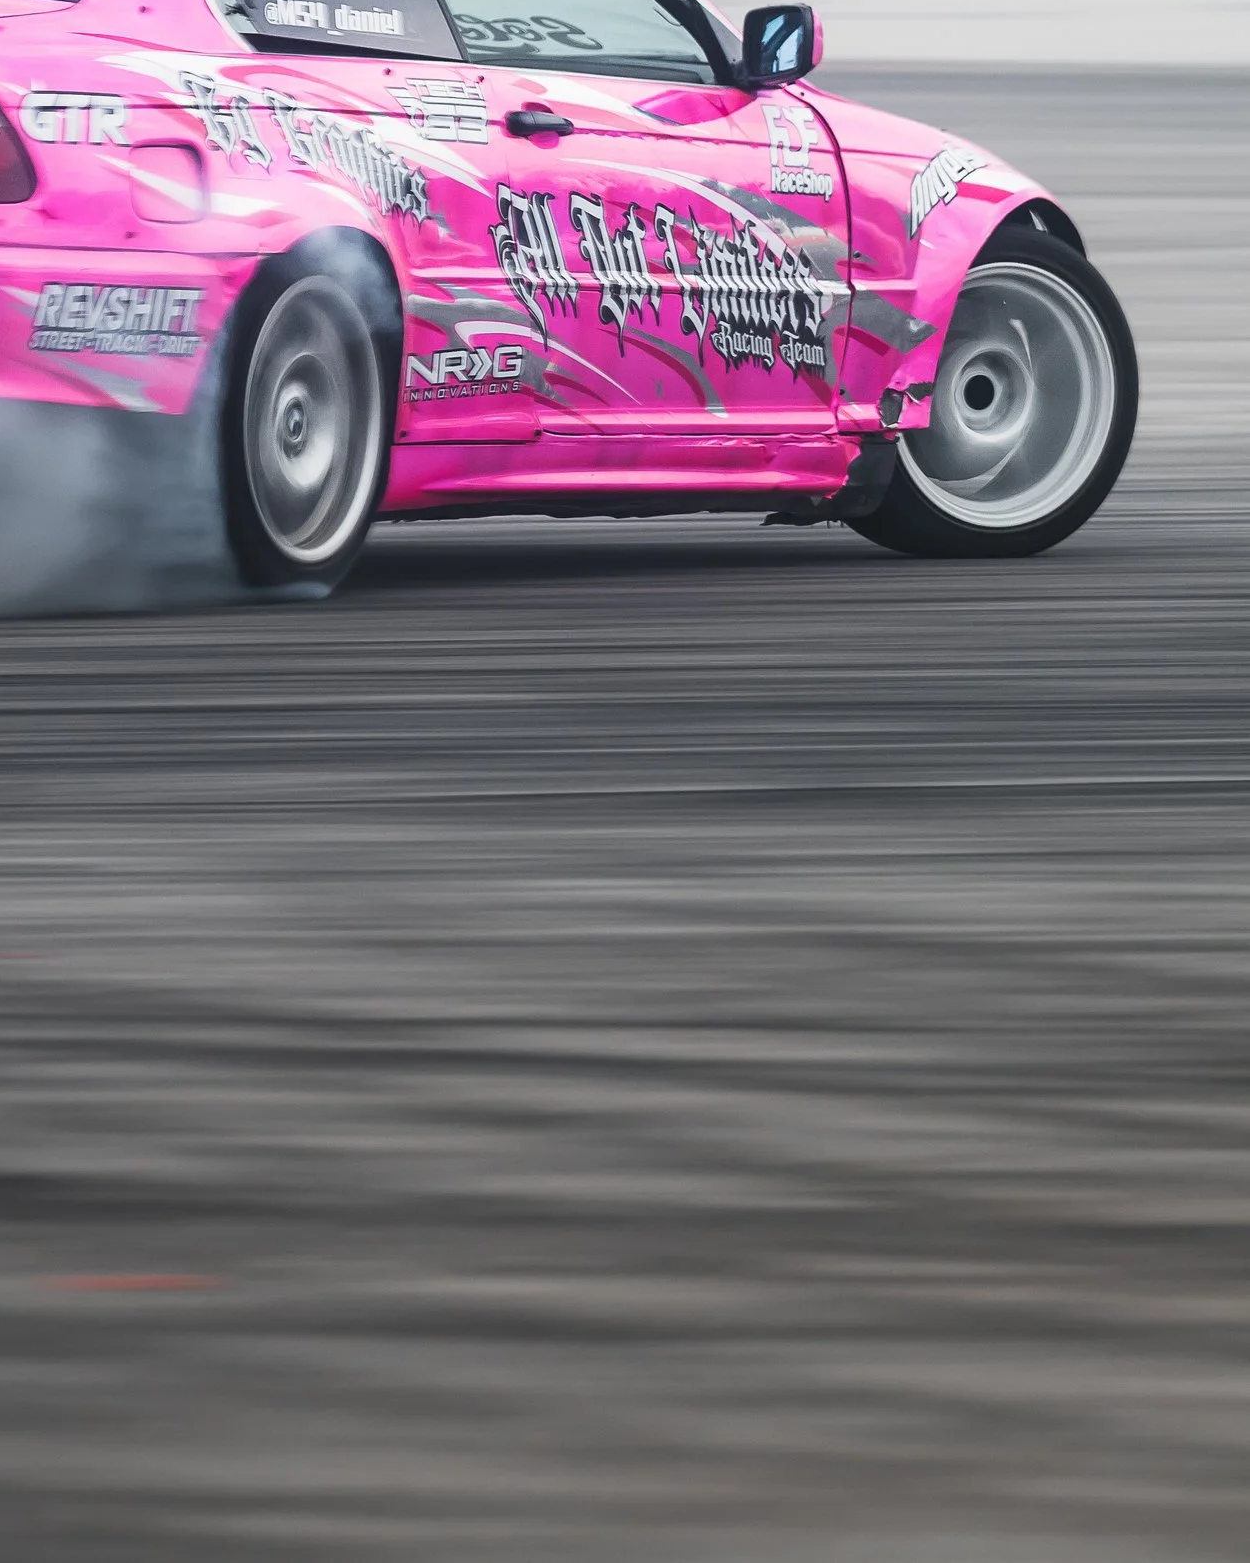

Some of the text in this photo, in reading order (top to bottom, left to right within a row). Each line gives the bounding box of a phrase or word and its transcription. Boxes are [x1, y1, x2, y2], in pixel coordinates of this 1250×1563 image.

[18, 91, 130, 147] GTR
[771, 167, 834, 203] RaceShop
[34, 282, 206, 333] REVSHIFT
[711, 321, 826, 372] Racing Team
[403, 381, 521, 402] INNOVATIONS
